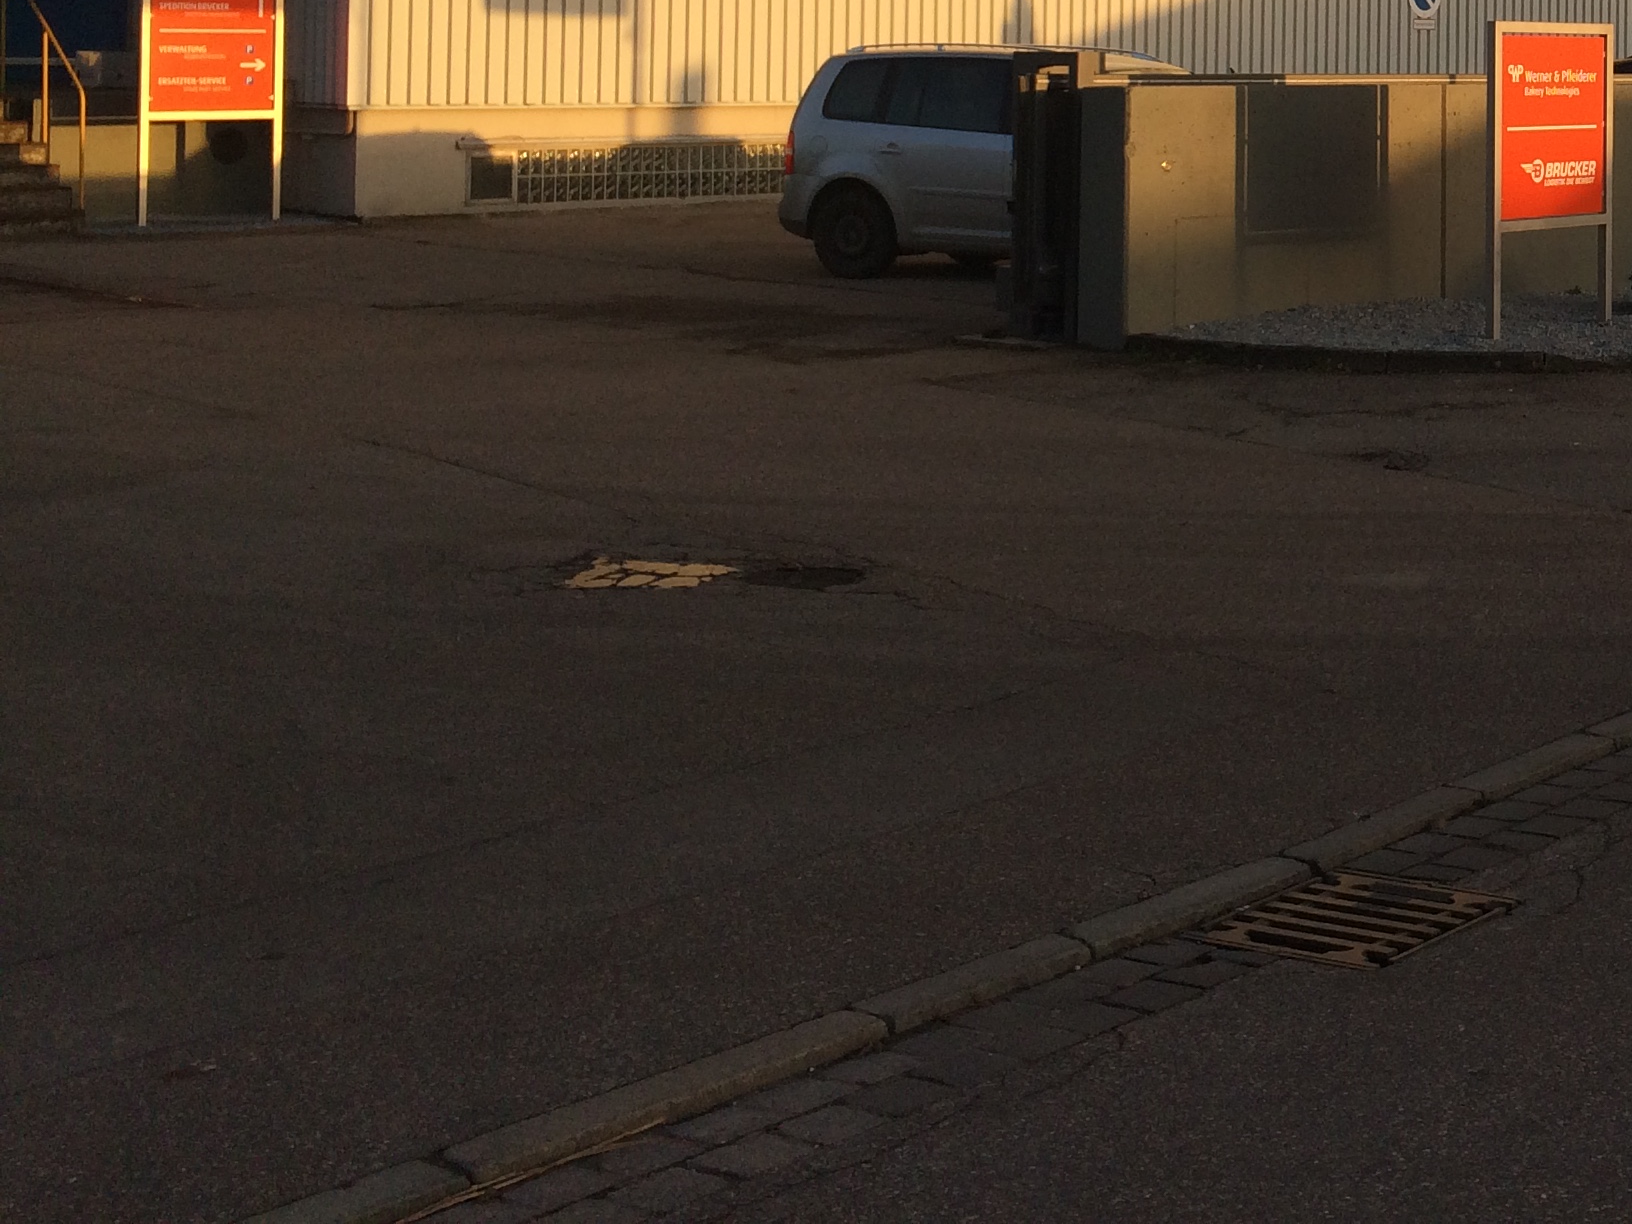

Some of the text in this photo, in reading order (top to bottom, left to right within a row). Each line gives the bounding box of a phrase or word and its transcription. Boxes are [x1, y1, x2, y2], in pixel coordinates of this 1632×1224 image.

[1525, 70, 1551, 83] Werner
[1554, 70, 1560, 82] &
[1562, 68, 1597, 83] Pfleiderer
[1545, 161, 1596, 178] BRUCKER
